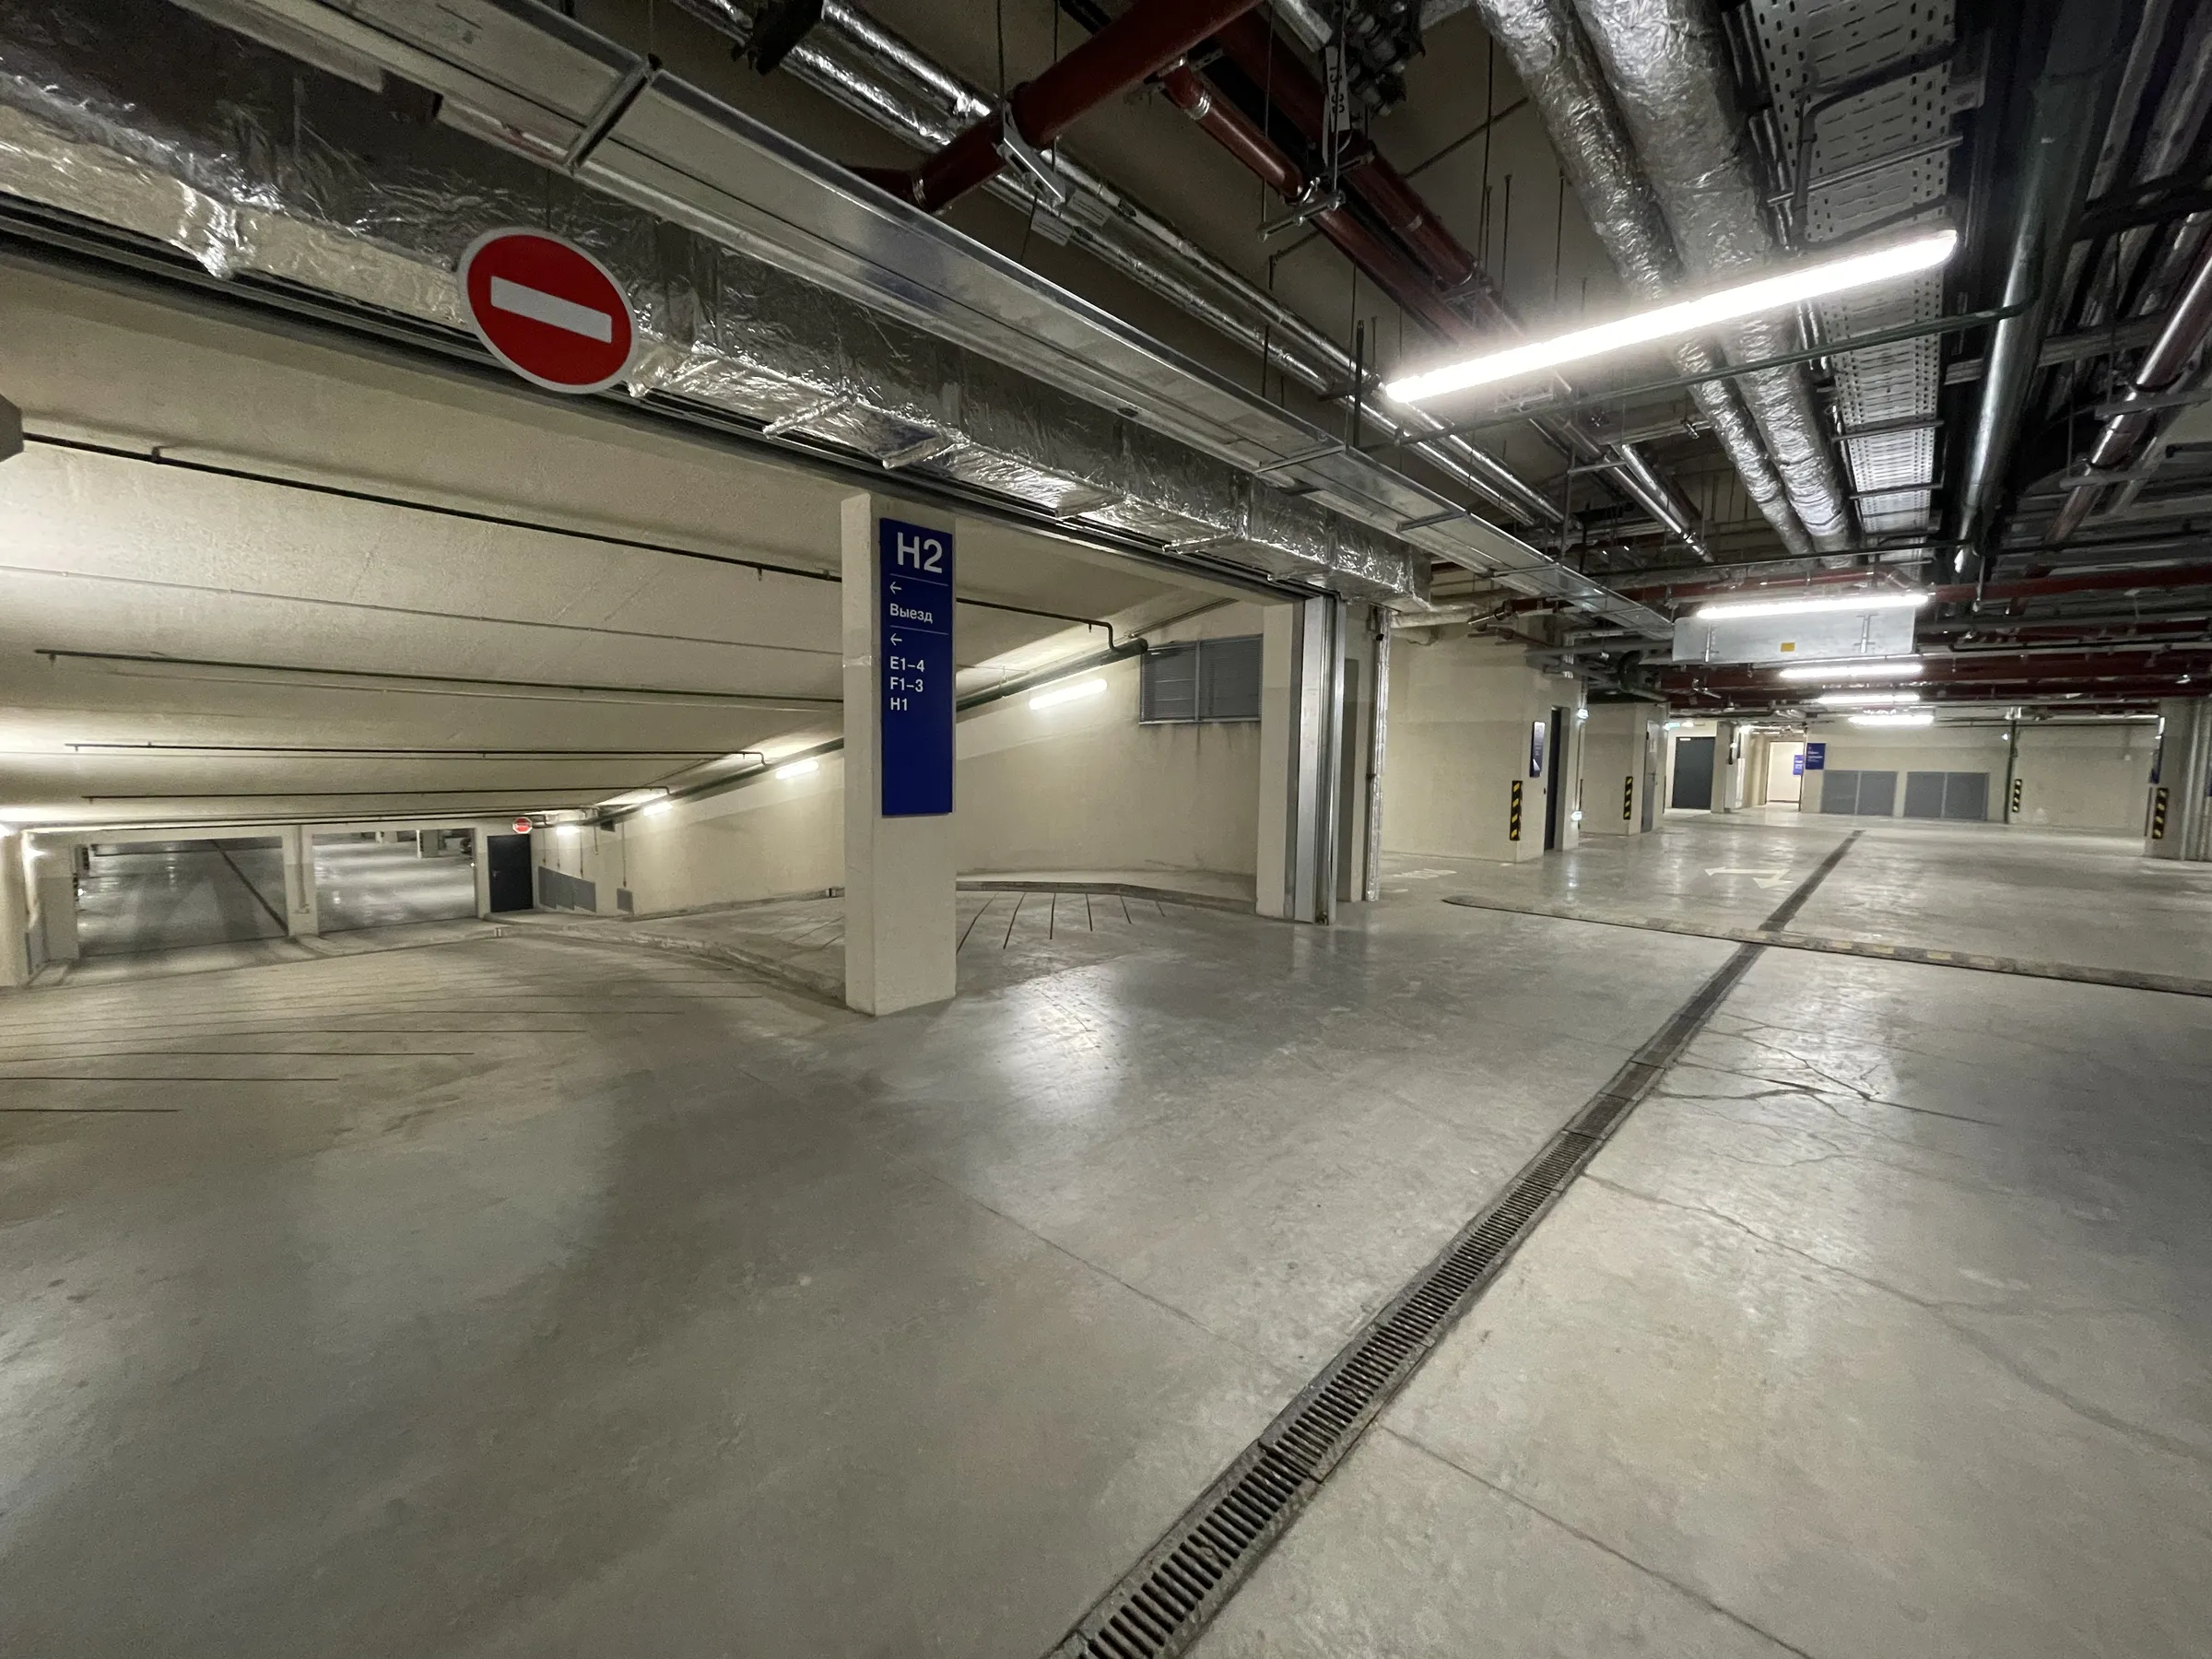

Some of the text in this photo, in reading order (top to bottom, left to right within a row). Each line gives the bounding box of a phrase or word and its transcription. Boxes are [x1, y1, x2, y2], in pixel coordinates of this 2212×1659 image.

[897, 532, 942, 573] H2
[889, 603, 933, 624] Выезд
[889, 698, 908, 711] H1
